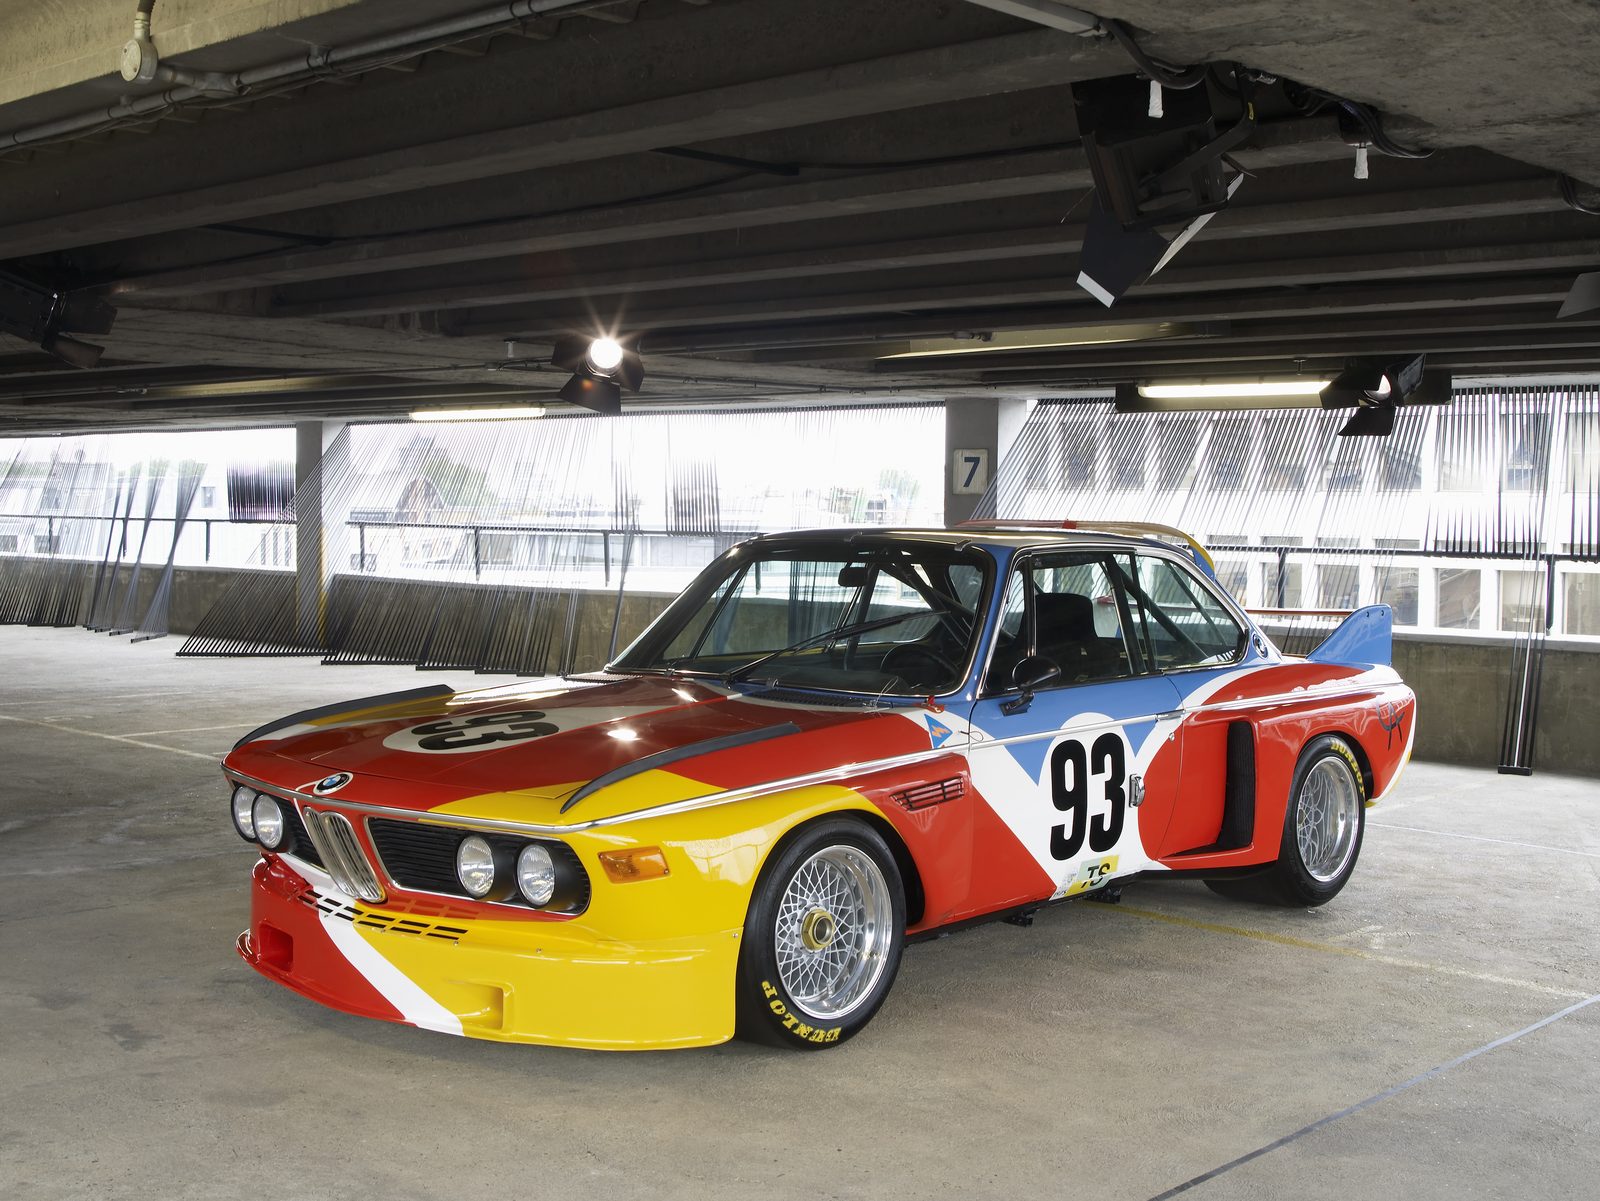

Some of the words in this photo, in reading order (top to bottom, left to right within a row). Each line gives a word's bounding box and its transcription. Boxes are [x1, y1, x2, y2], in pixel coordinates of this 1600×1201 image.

[963, 456, 981, 488] 7
[411, 710, 560, 751] 93
[1049, 732, 1126, 861] 93
[761, 980, 842, 1043] DUNLOP
